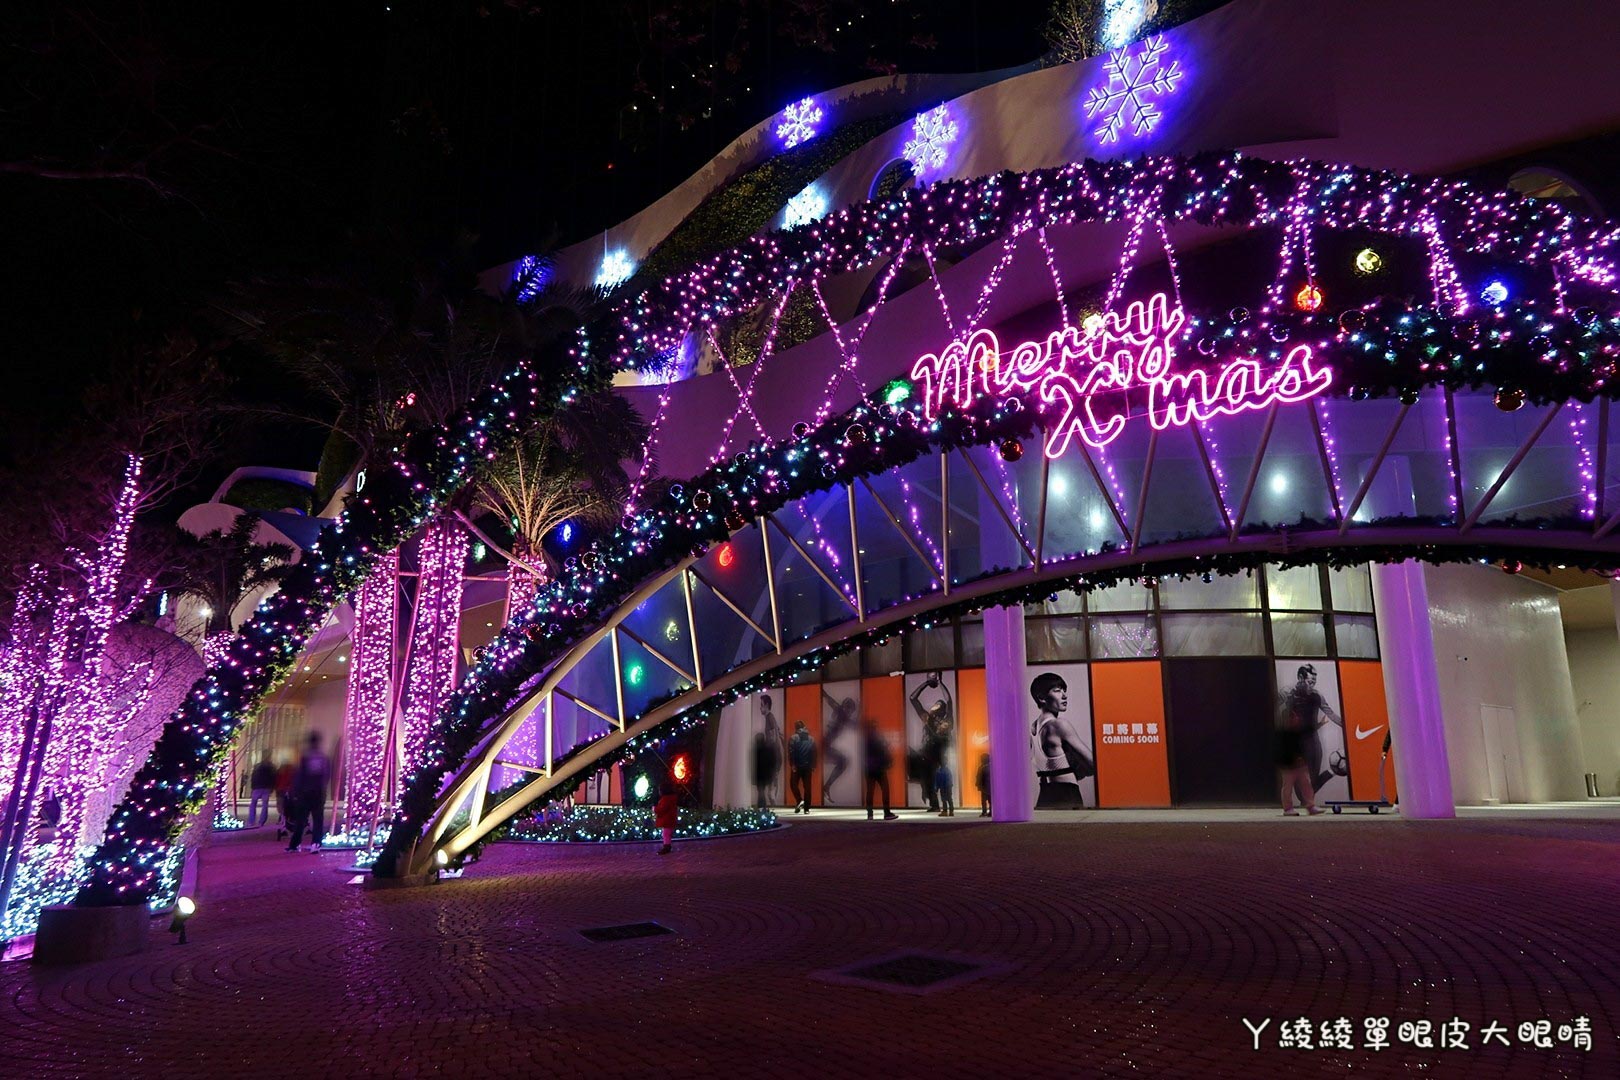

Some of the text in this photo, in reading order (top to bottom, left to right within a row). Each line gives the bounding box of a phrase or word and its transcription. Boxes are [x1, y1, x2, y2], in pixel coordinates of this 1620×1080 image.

[910, 292, 1186, 423] Merry
[1102, 735, 1160, 744] COMING SOON
